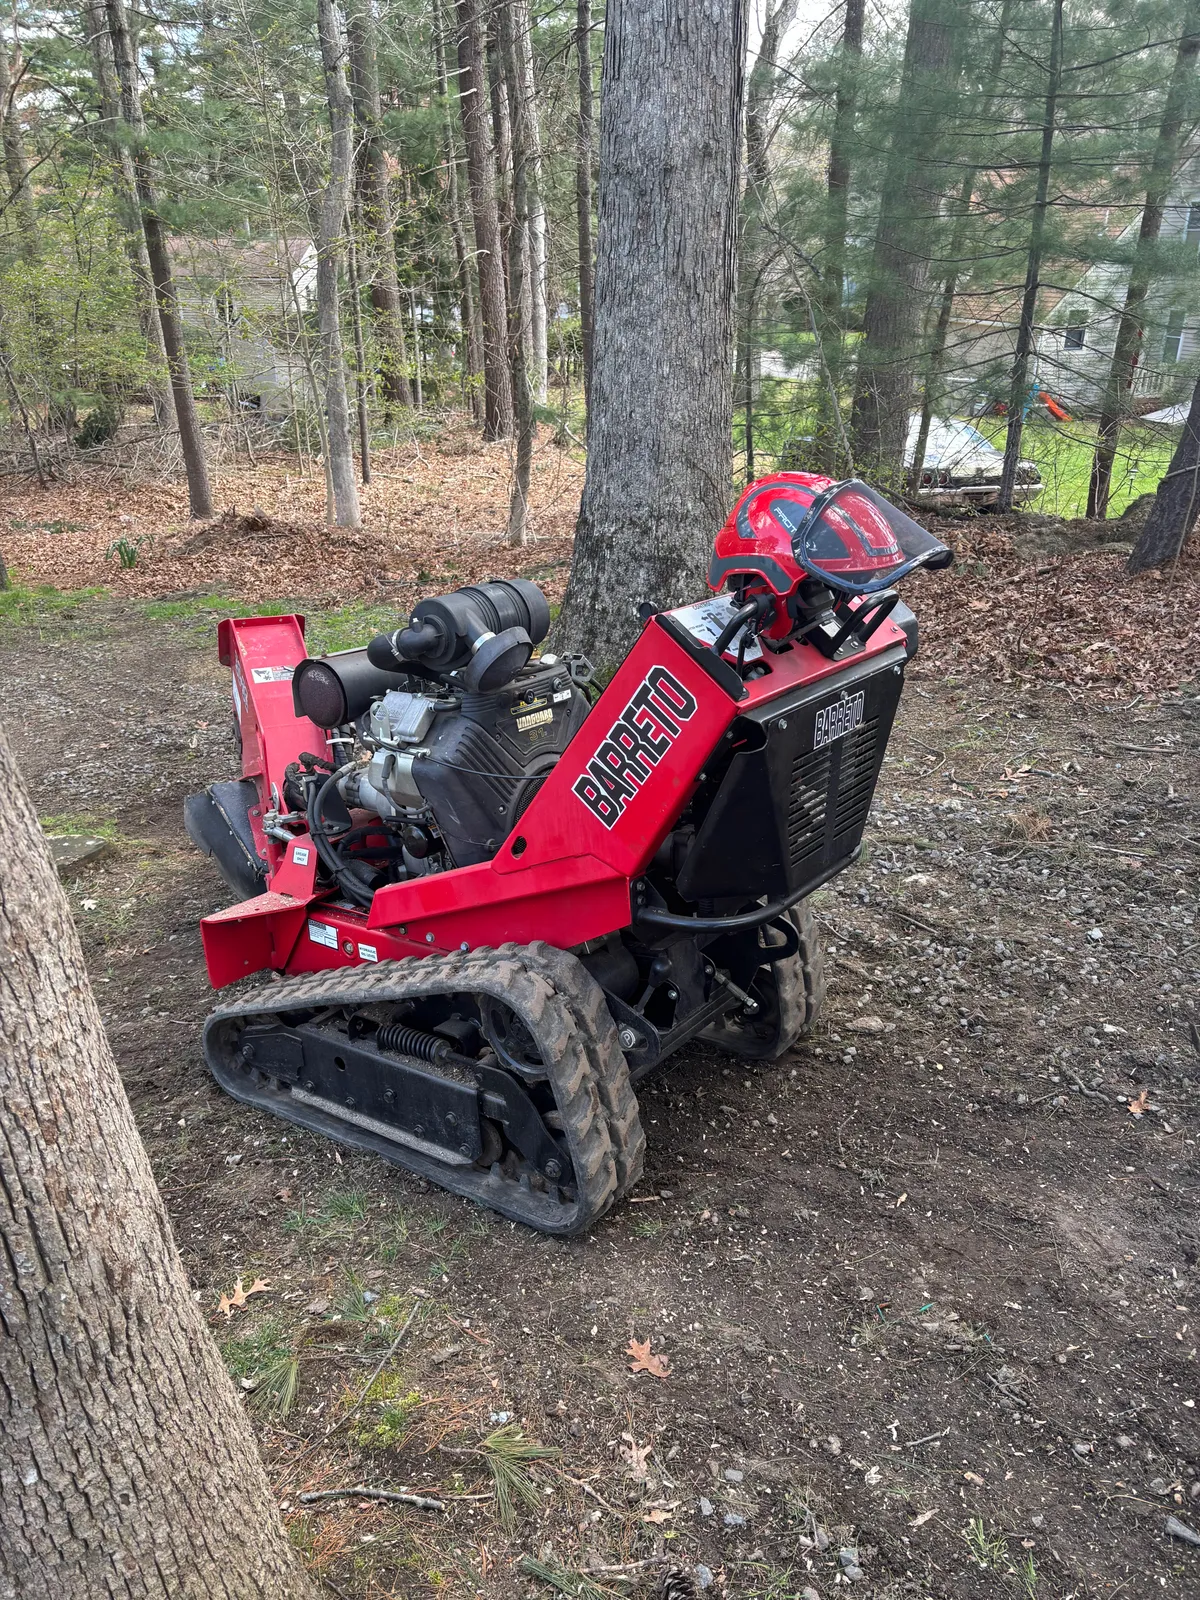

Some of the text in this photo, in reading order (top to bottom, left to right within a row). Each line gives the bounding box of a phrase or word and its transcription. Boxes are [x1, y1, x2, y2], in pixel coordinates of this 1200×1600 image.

[773, 506, 797, 533] PROT
[571, 665, 698, 831] BARRETO
[813, 690, 865, 749] BARRETO
